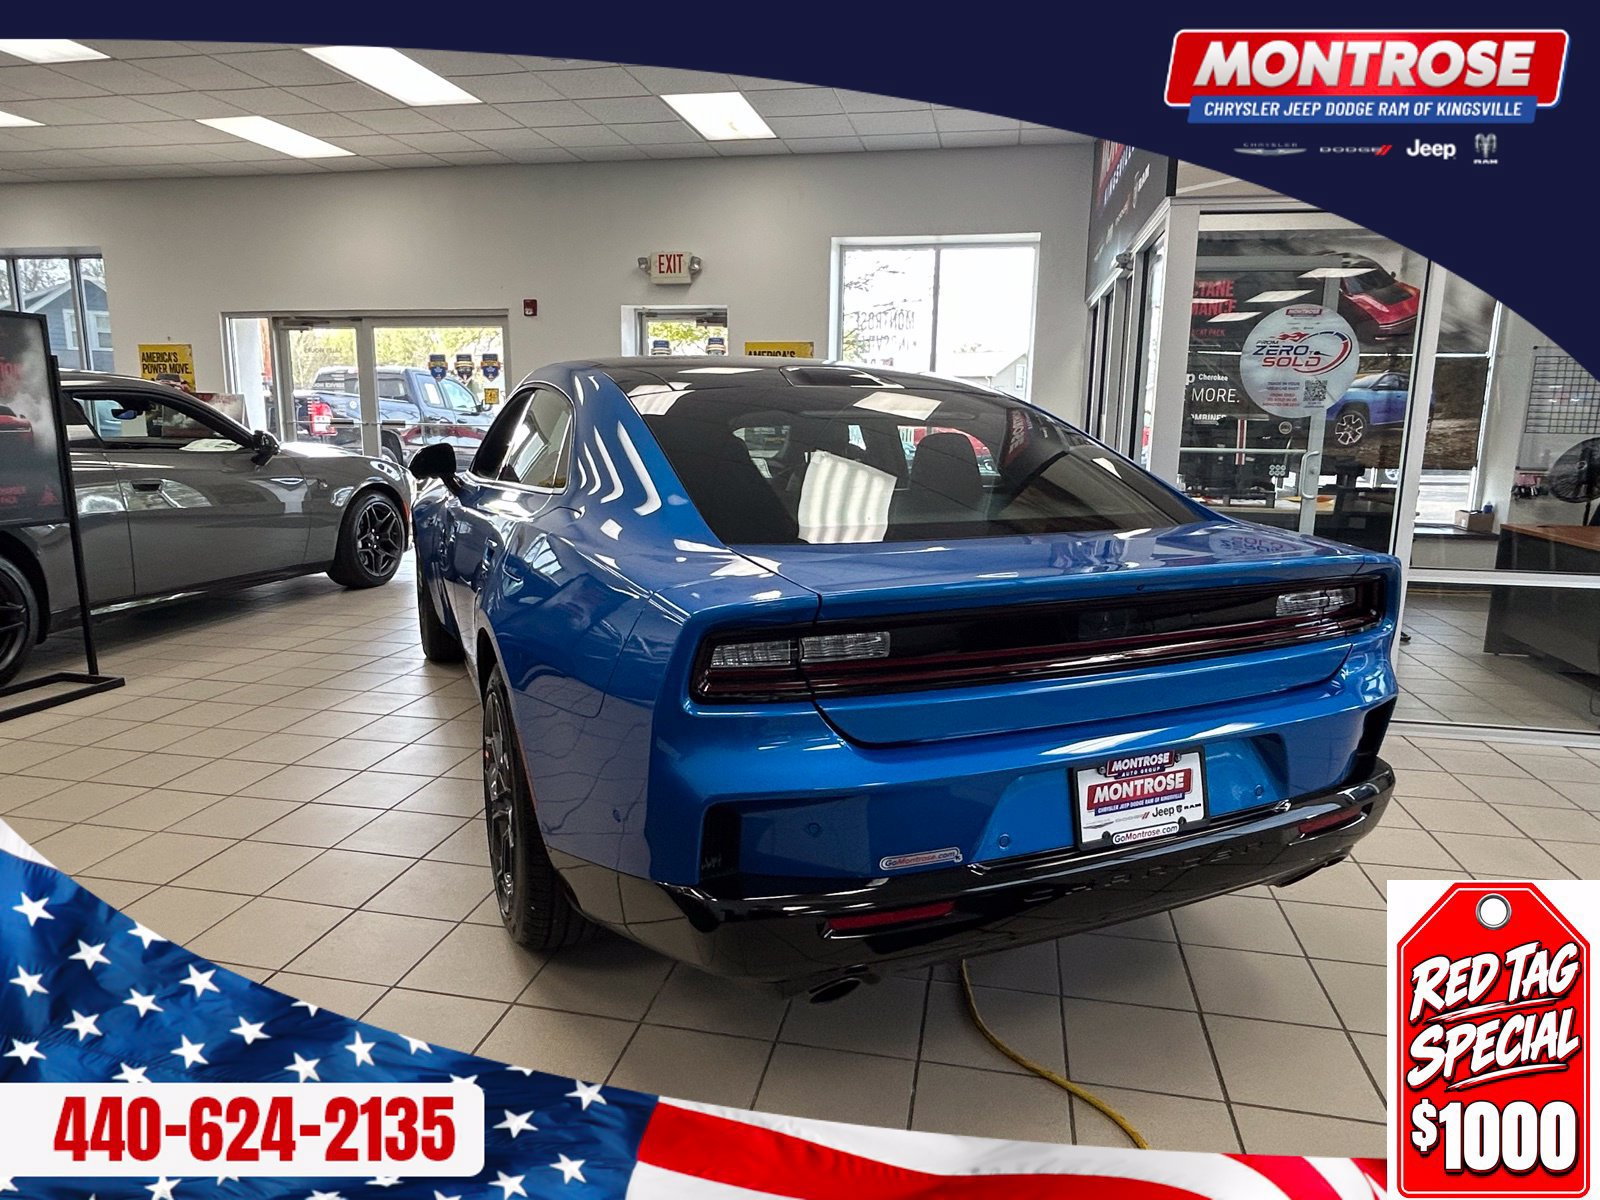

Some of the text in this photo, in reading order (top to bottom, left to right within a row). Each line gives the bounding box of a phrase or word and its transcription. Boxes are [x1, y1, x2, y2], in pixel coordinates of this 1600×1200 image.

[658, 254, 683, 273] EXIT
[1252, 345, 1309, 355] ZERO
[142, 352, 179, 362] AMERICA'S
[1262, 357, 1321, 367] SOLD
[142, 363, 168, 374] POWER
[1198, 374, 1229, 382] Cherokee
[1191, 387, 1240, 403] MORE.
[1111, 752, 1170, 772] MONTROSE
[1121, 767, 1161, 778] AUTO GROUP
[1093, 772, 1185, 803] MONTROSE
[1152, 807, 1174, 817] Jeep
[1114, 825, 1177, 843] GoMontrose.com
[885, 852, 956, 867] GoMontrose.com
